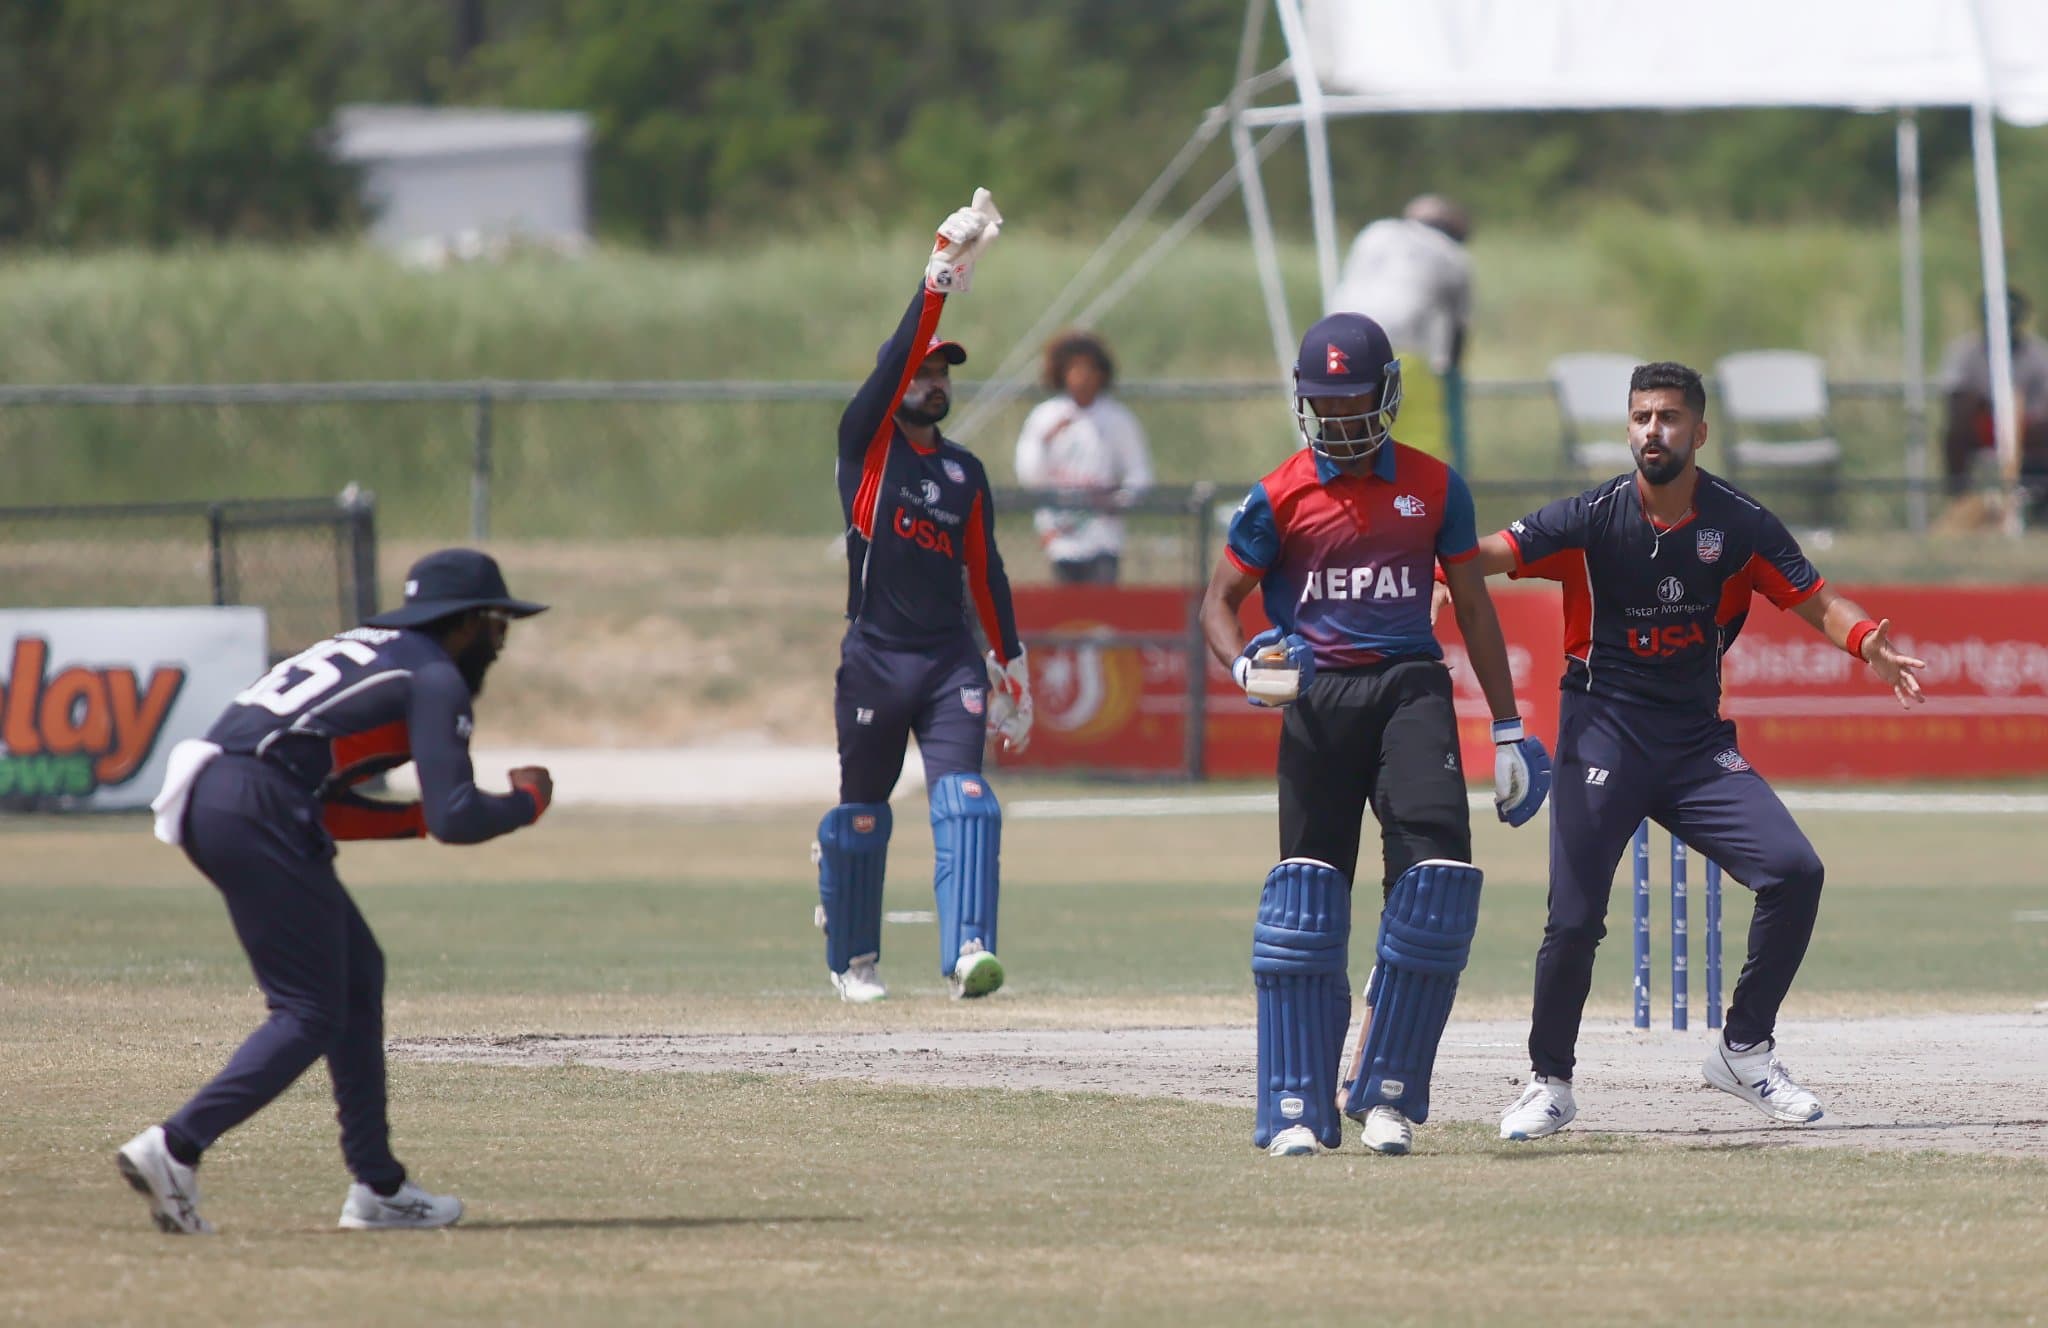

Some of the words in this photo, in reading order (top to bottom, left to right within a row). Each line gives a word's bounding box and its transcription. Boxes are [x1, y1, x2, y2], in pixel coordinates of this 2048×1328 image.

[894, 506, 954, 559] USA
[1699, 531, 1721, 543] USA
[1301, 566, 1417, 603] NEPAL
[1625, 607, 1658, 617] Sistar
[1627, 622, 1705, 657] USA
[0, 638, 185, 785] lay
